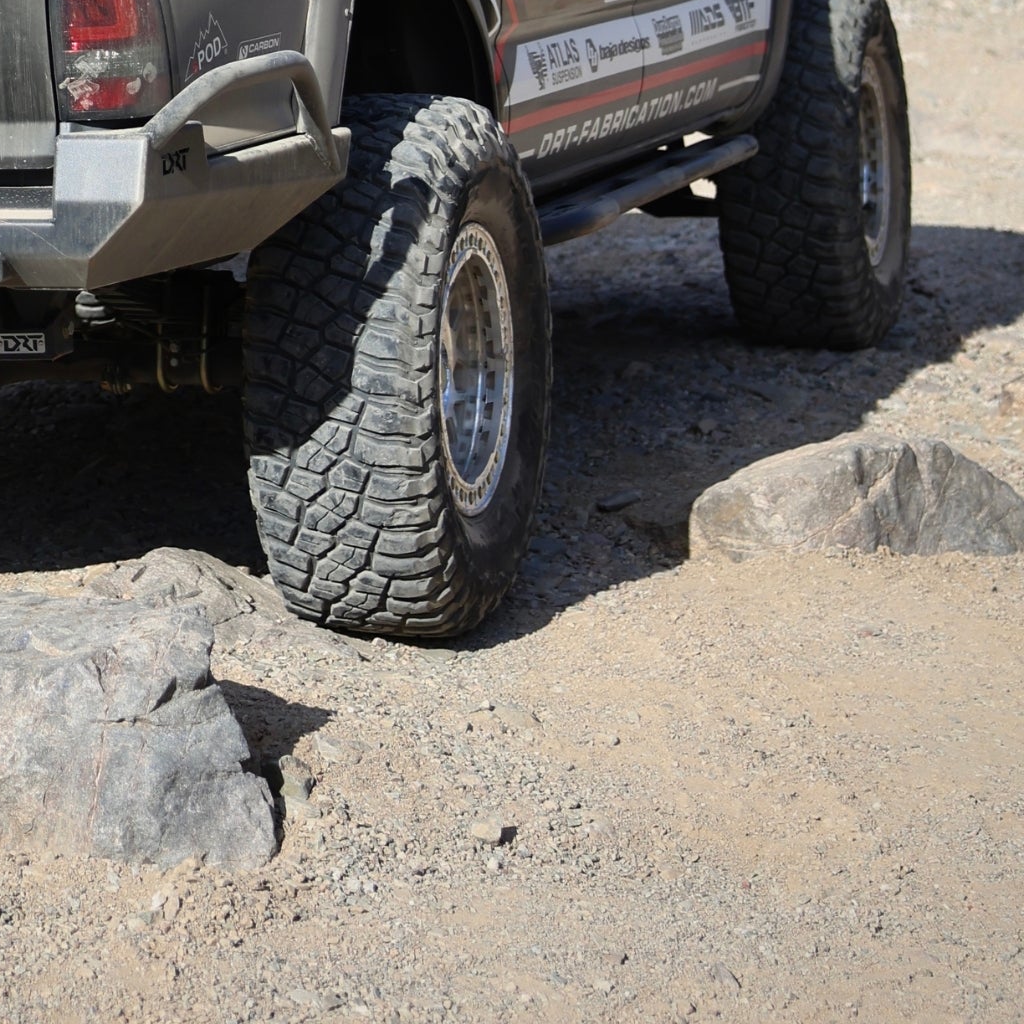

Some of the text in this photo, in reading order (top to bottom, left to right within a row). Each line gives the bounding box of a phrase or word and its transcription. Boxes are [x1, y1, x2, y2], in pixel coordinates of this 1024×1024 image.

[249, 37, 280, 53] CARBON
[546, 38, 580, 69] ATLAS
[536, 77, 718, 159] DRT-FABRICATION.COM
[1, 334, 43, 352] DRT
